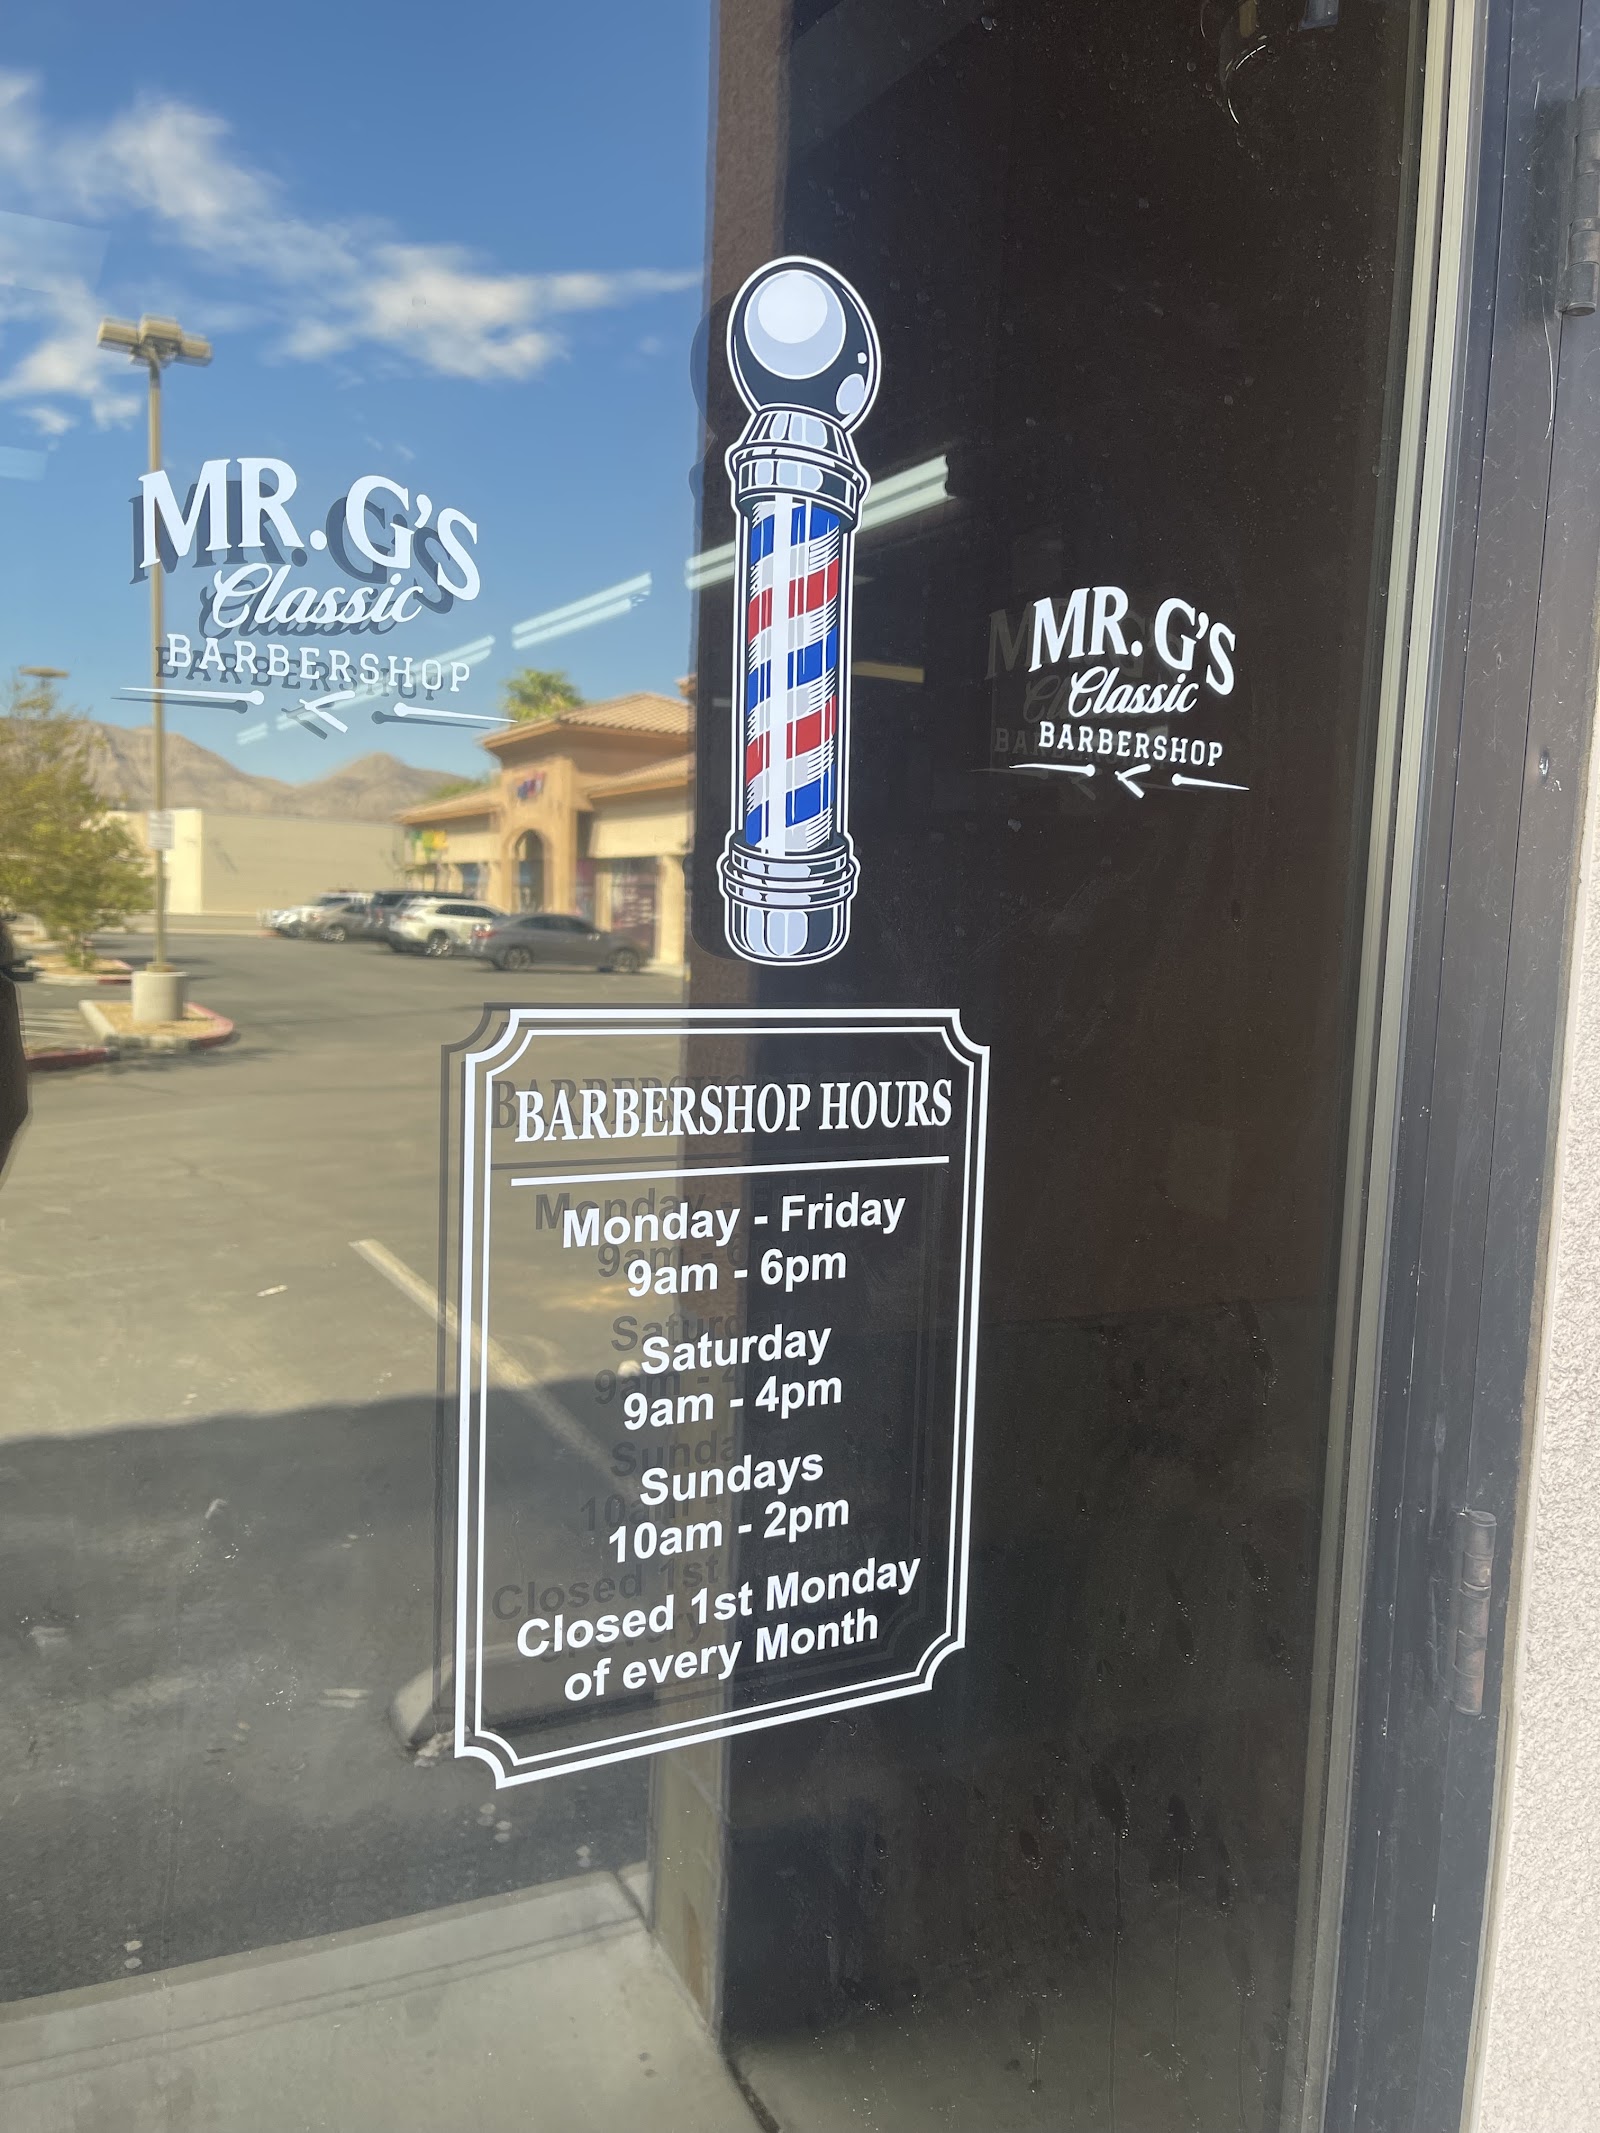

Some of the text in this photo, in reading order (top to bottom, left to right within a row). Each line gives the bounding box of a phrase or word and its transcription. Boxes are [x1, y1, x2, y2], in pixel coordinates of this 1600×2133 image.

[137, 457, 481, 602] MR. G'S
[213, 562, 425, 629] Classic
[166, 633, 471, 692] BARBERSHOP
[1028, 585, 1236, 696] MR. G'S
[1067, 665, 1200, 718] Classic
[1038, 720, 1223, 767] BARBERSHOP
[514, 1077, 953, 1143] BARBERSHOP HOURS
[562, 1201, 741, 1249] Monday
[781, 1192, 906, 1235] Friday
[627, 1257, 719, 1298] 9am
[759, 1248, 847, 1292] 6pm
[640, 1323, 833, 1376] Saturday
[622, 1390, 714, 1431] 9am
[754, 1374, 843, 1419] 4pm
[639, 1452, 824, 1506] Sundays
[608, 1518, 723, 1564] 10am
[763, 1498, 850, 1542] 2pm
[516, 1557, 922, 1658] Closed 1st Monday
[564, 1607, 879, 1702] of every Month
